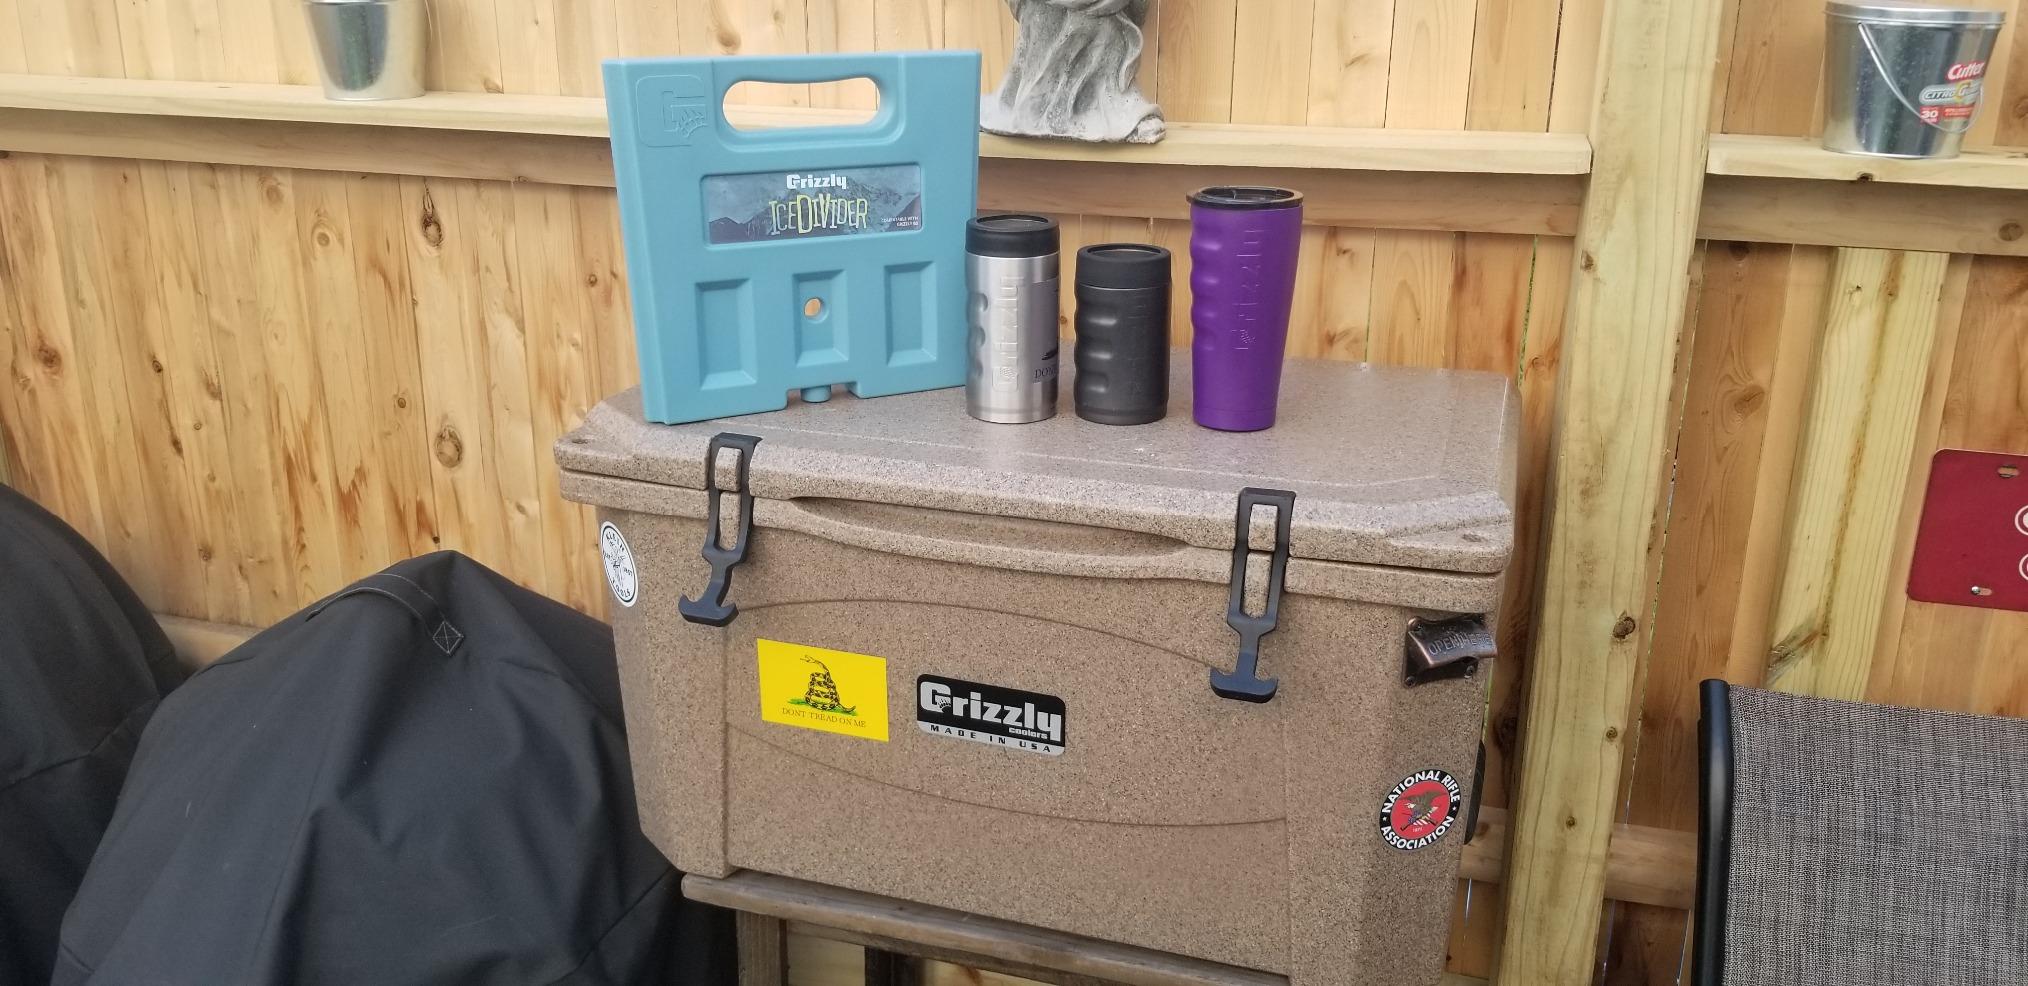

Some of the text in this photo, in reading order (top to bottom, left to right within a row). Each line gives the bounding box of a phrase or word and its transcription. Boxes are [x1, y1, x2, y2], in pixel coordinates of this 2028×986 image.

[1920, 110, 1938, 118] 30
[786, 173, 847, 190] Grizzly
[782, 707, 866, 728] DONT TREAD ON ME
[920, 681, 1062, 742] Grizzly
[930, 724, 1051, 753] MADE IN USA
[1008, 726, 1048, 740] coolers
[1381, 770, 1461, 814] NATIONAL RIFLE
[1380, 815, 1455, 850] ASSOCIATION
